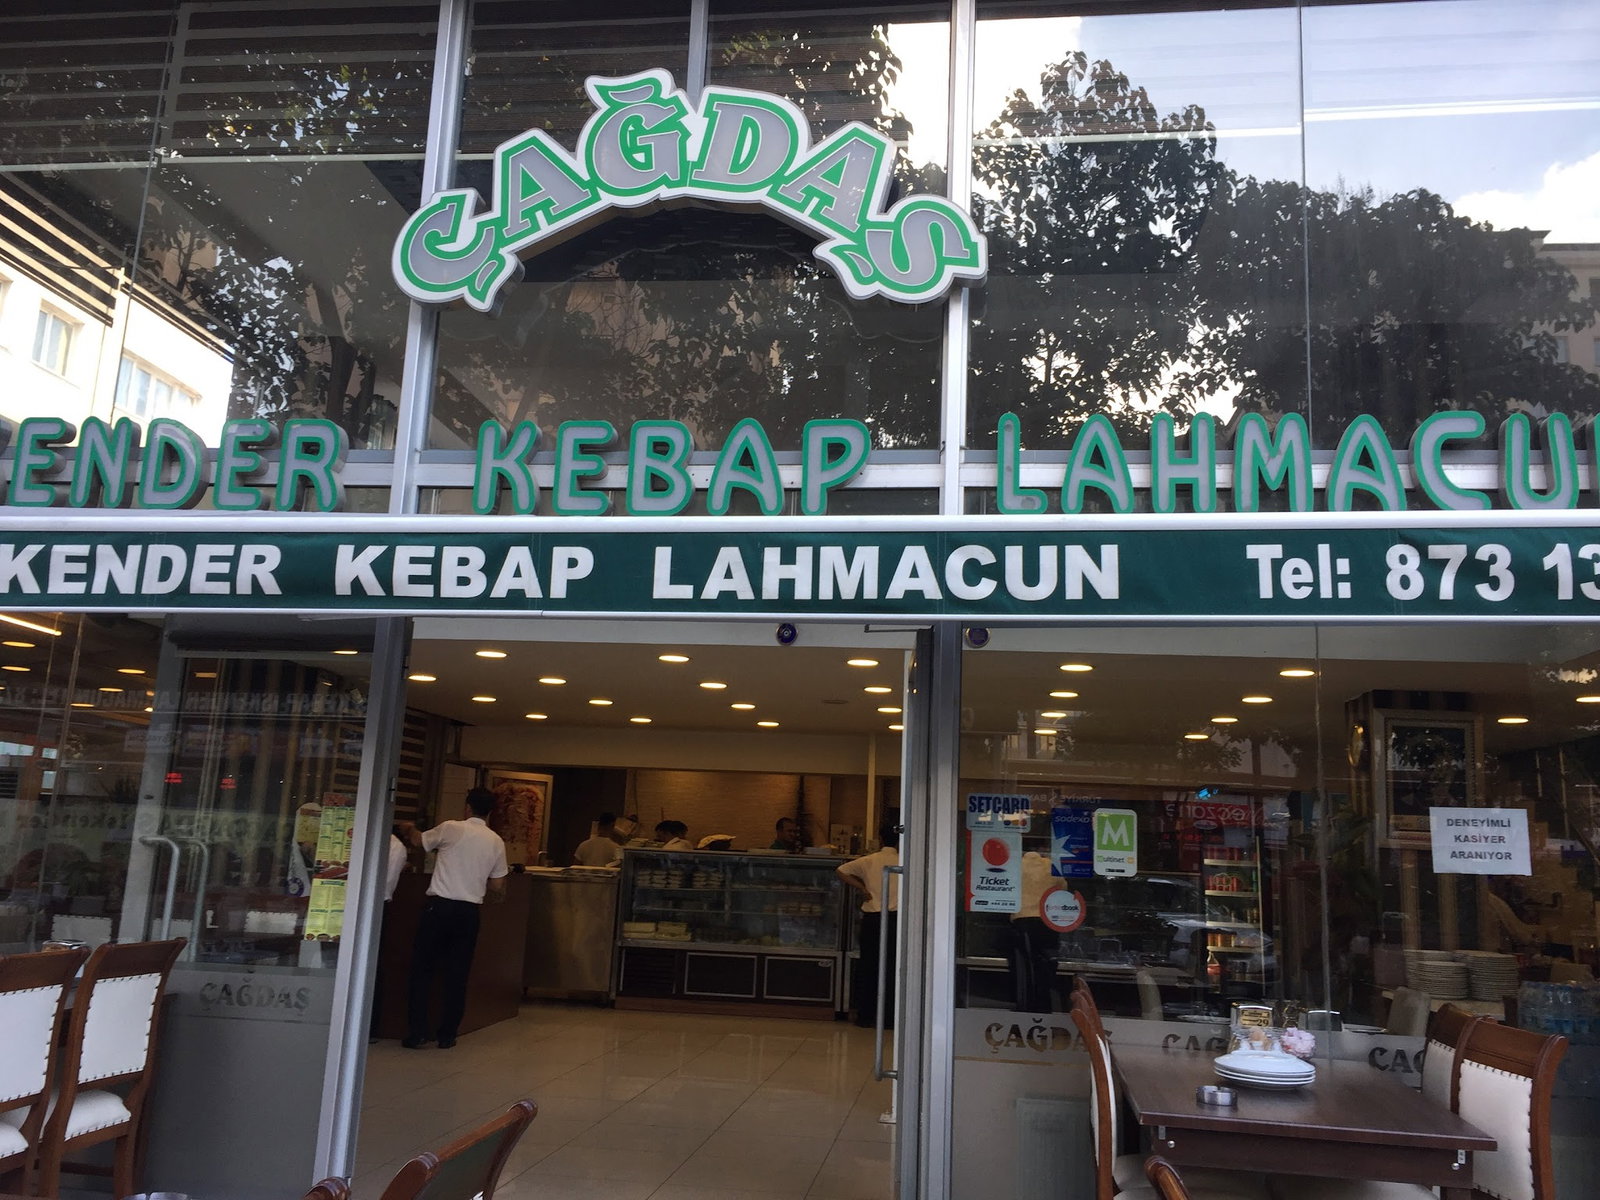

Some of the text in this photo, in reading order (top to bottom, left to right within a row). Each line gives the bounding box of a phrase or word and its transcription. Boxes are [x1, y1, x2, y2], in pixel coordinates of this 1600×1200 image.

[398, 74, 980, 305] ÇAĞDAŞ
[473, 417, 870, 516] KEBAP
[998, 411, 1600, 513] LAHMACU
[0, 543, 283, 597] KENDER
[335, 545, 596, 599] KEBAP
[651, 544, 1120, 601] LAHMACUN
[1245, 543, 1351, 600] Tel:
[1385, 543, 1515, 602] 873
[968, 795, 1030, 814] SETCARD
[1055, 813, 1091, 824] sodexo
[1446, 817, 1511, 828] DENEYİMLİ
[1454, 833, 1506, 844] KASİYER
[1450, 850, 1512, 861] ARANIYOR
[979, 876, 1010, 886] Ticket
[201, 976, 312, 1016] ÇAĞDAŞ
